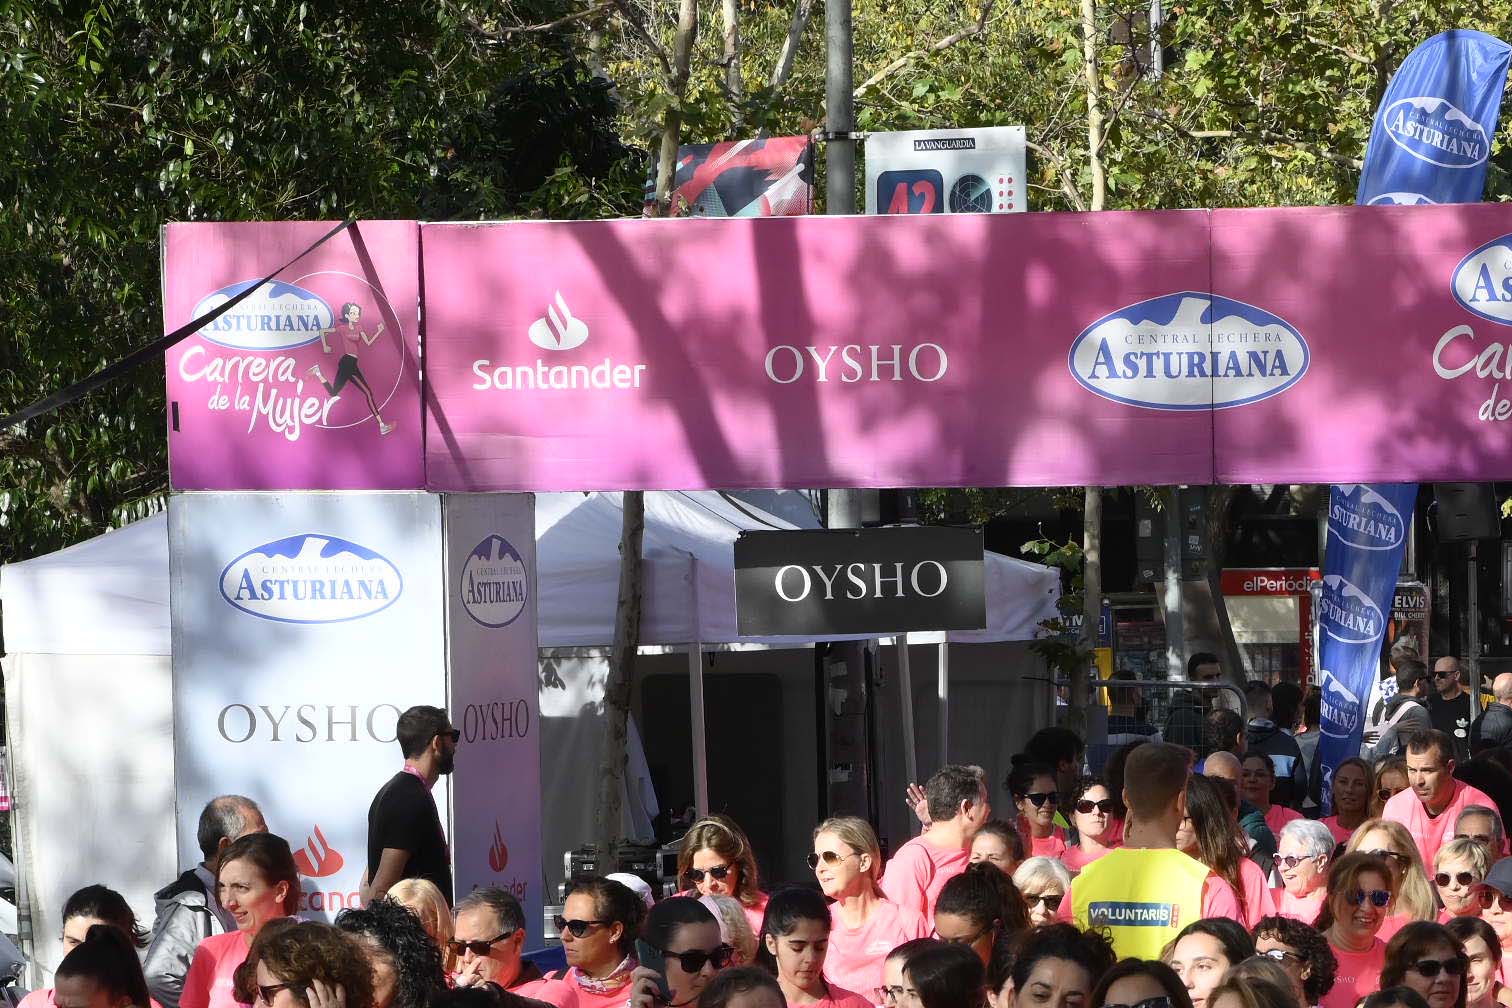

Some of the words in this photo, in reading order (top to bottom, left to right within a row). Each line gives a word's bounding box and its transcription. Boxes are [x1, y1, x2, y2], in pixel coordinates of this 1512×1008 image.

[1391, 109, 1480, 160] ASTURIANA
[1124, 333, 1199, 345] CENTRAL
[1207, 331, 1283, 344] LECHERA
[178, 345, 297, 384] Carrera
[473, 357, 646, 391] Santander
[765, 342, 949, 384] OYSHO
[1088, 336, 1290, 381] ASTURIANA
[208, 384, 230, 410] de
[234, 383, 251, 410] la
[248, 379, 341, 441] Mujer
[1479, 384, 1511, 421] de
[235, 568, 389, 601] ASTURIANA
[466, 570, 524, 604] ASTURIANA
[774, 560, 948, 602] OYSHO
[1395, 596, 1425, 608] ELVIS
[464, 699, 529, 743] OYSHO
